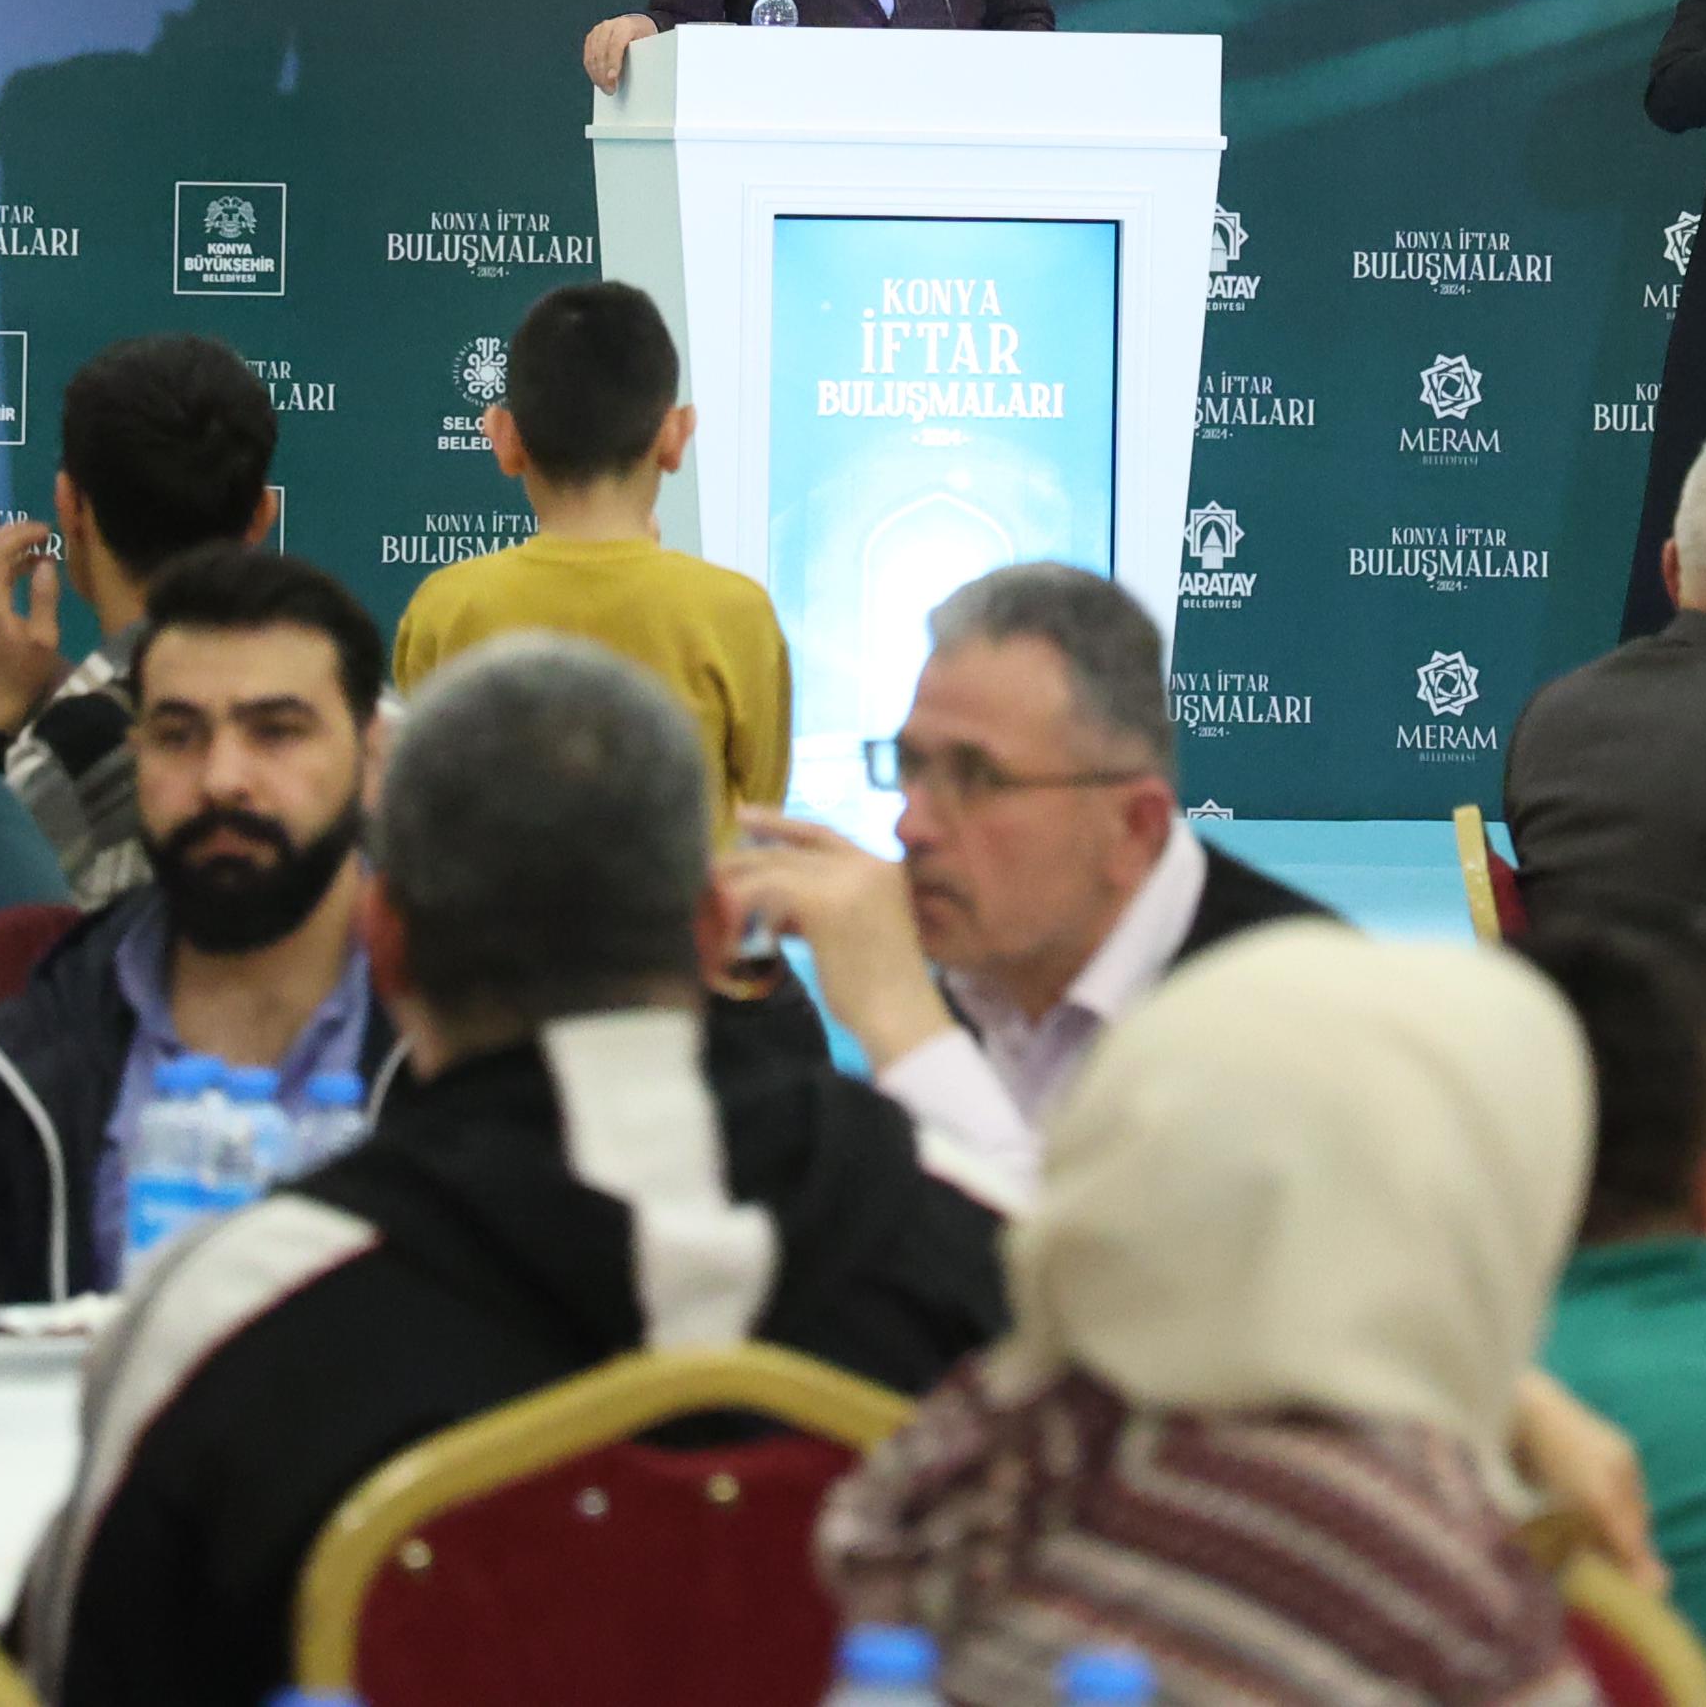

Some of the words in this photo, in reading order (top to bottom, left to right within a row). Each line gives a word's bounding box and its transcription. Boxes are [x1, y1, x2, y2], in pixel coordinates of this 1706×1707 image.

[431, 212, 490, 231] KONYA
[497, 208, 550, 232] İFTAR
[207, 242, 253, 255] KONYA
[387, 233, 593, 268] BULUŞMALARI
[1395, 230, 1453, 250] KONYA
[1459, 227, 1510, 251] İFTAR
[1353, 251, 1552, 285] BULUŞMALARI
[882, 279, 1002, 316] KONYA
[1209, 276, 1260, 299] RATAY
[861, 309, 1020, 374] İFTAR
[245, 360, 291, 379] TAR
[1221, 371, 1272, 395] İFTAR
[817, 380, 1064, 423] BULUŞMALARI
[1194, 398, 1315, 428] ŞMALARI
[443, 417, 485, 433] SELÇ
[438, 438, 492, 450] BELED
[1399, 427, 1501, 453] MERAM
[426, 514, 485, 533] KONYA
[492, 511, 539, 533] İFTA
[1392, 527, 1449, 546] KONYA
[1456, 523, 1506, 547] İFTAR
[1349, 548, 1548, 583] BULUŞMALARI
[1177, 573, 1256, 597] ARATAY
[1169, 674, 1210, 691] NYA
[1217, 669, 1269, 692] İFTAR
[1169, 696, 1311, 728] UŞMALARI
[1396, 724, 1497, 750] MERAM
